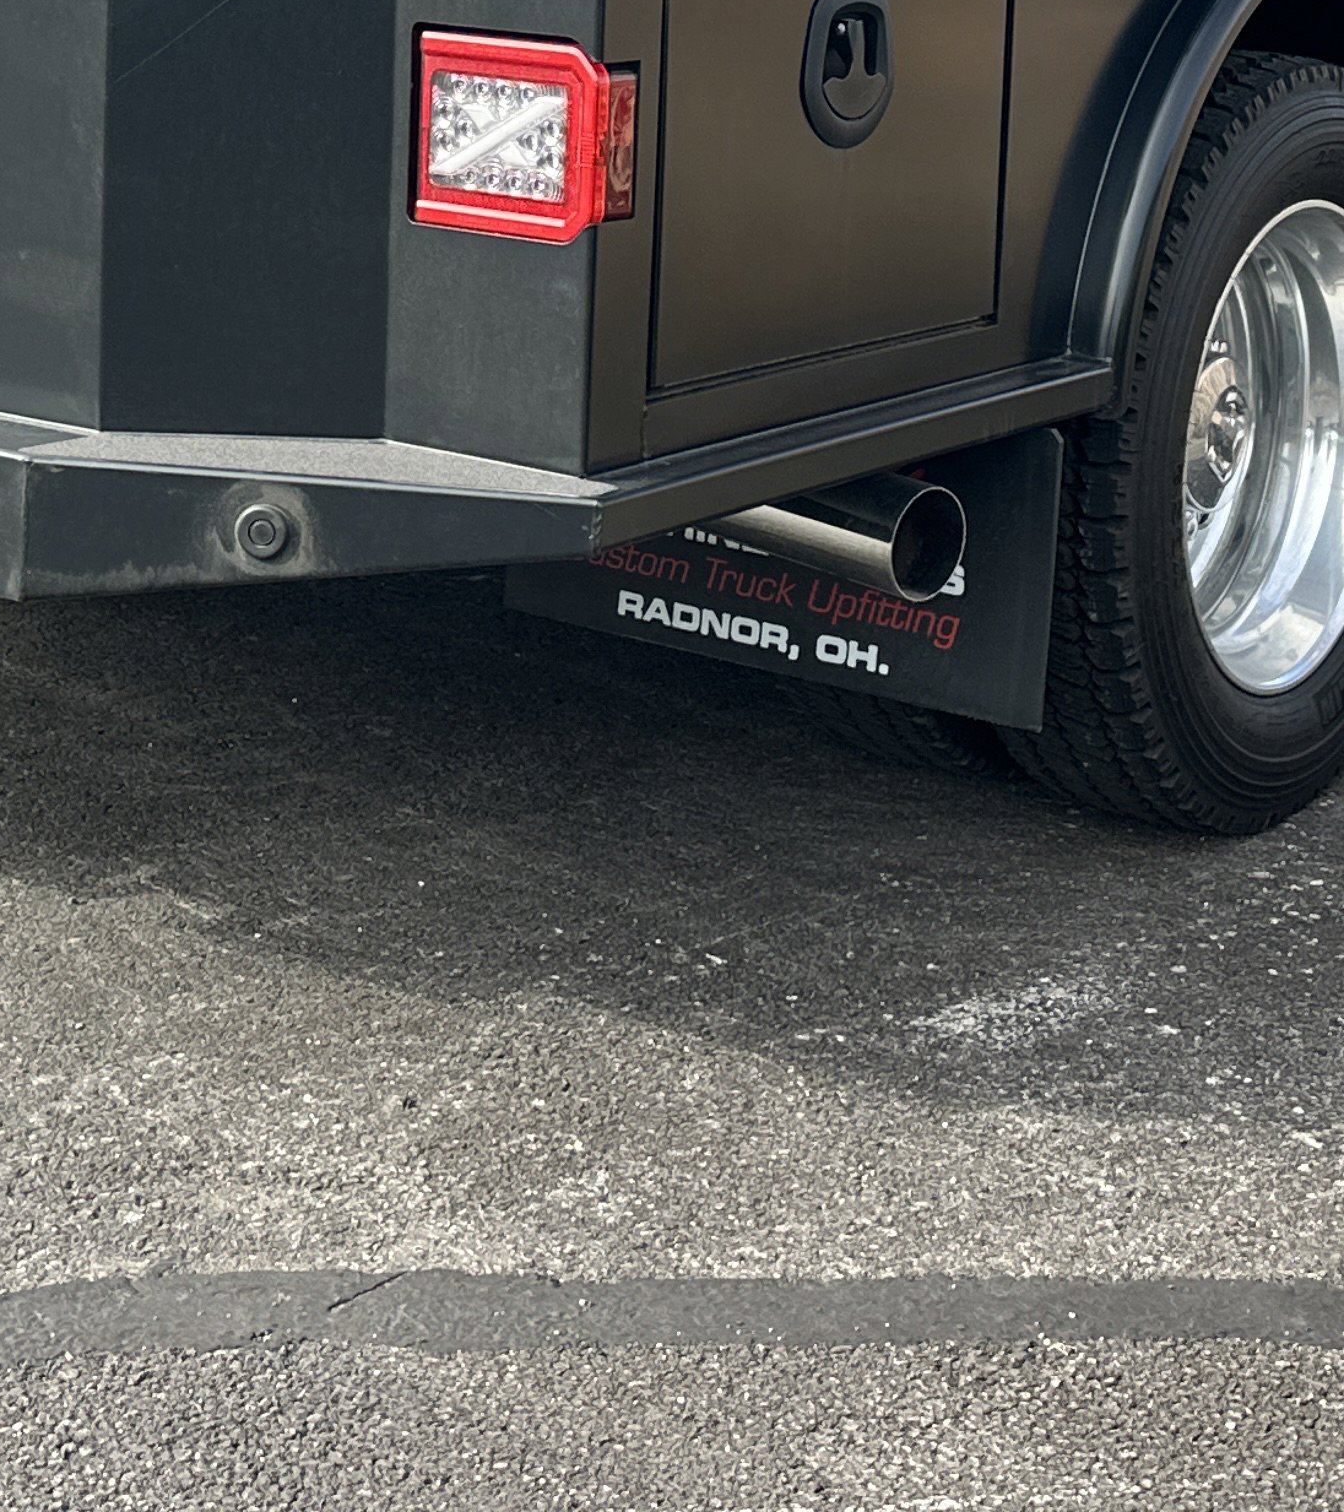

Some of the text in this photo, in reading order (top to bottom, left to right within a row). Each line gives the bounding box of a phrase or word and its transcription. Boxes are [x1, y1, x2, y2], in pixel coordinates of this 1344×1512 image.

[584, 544, 691, 585] ustom
[705, 555, 795, 607] Truck
[807, 578, 961, 650] Upfitting
[616, 589, 890, 676] RADNOR, OH.
